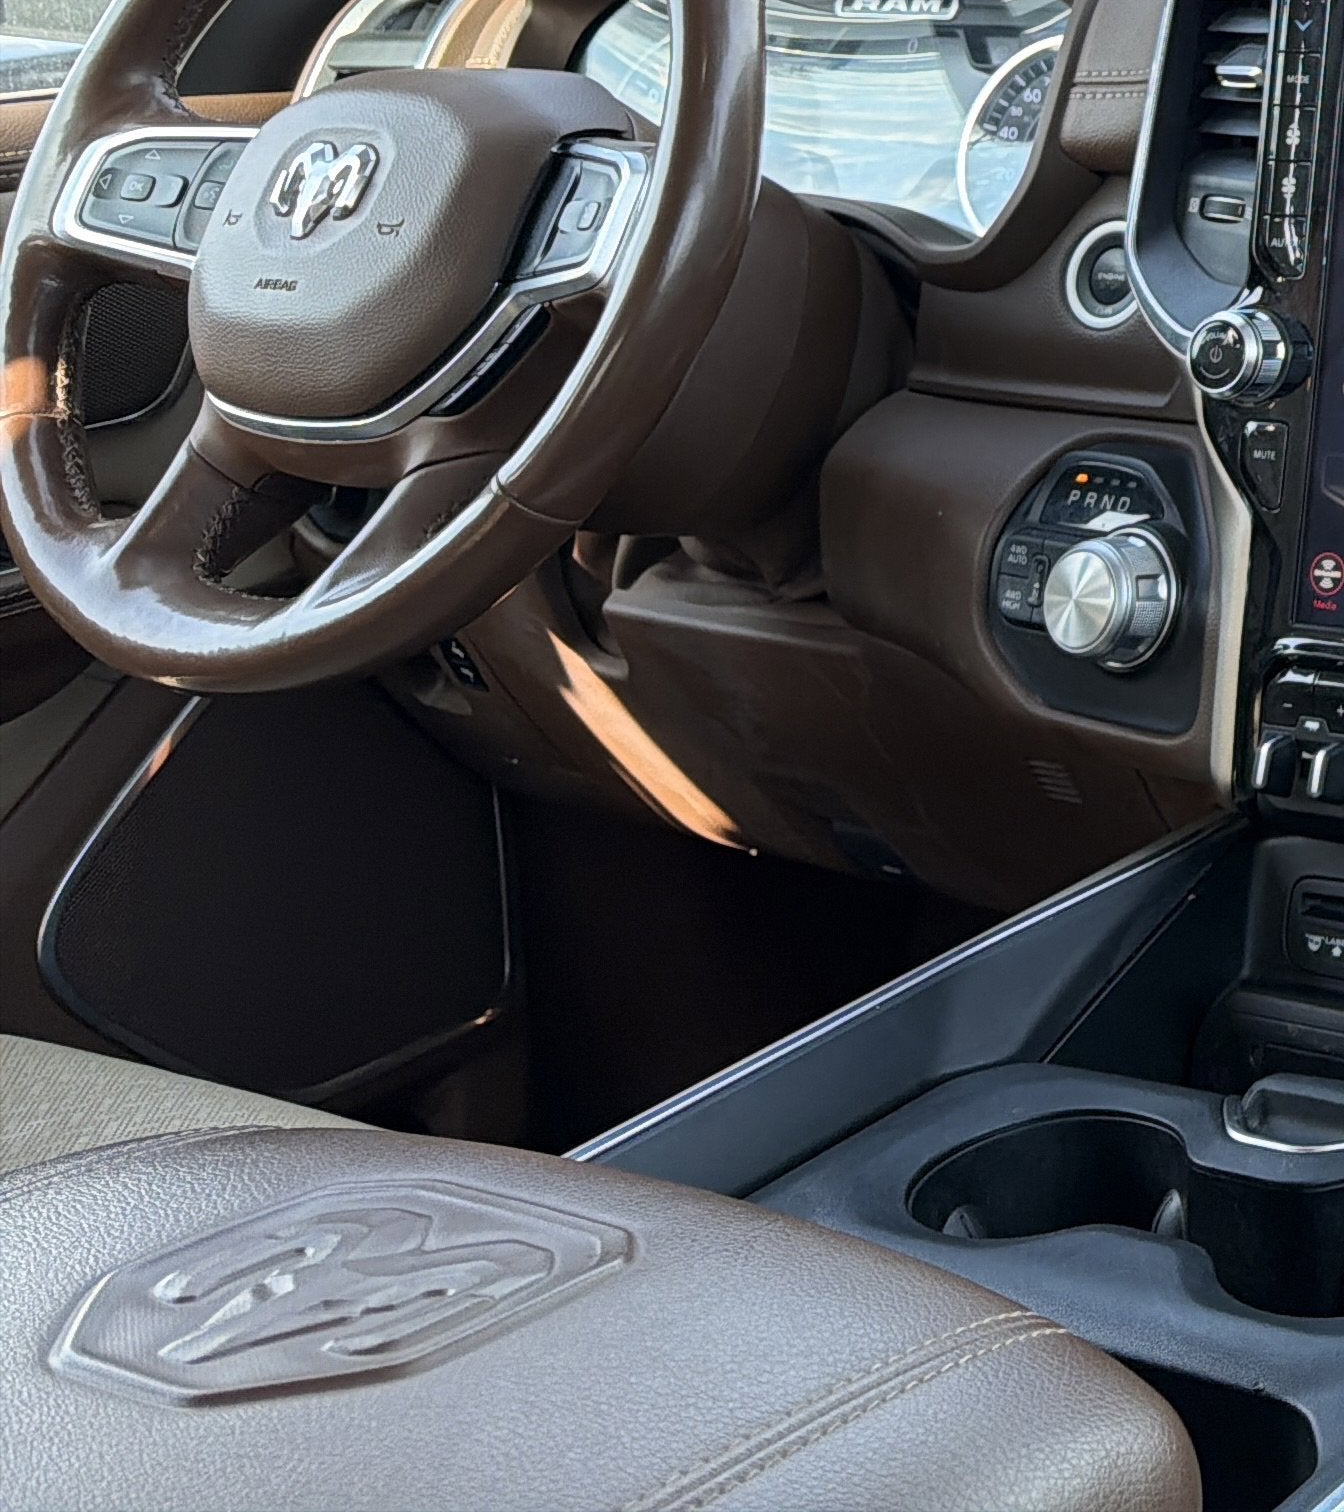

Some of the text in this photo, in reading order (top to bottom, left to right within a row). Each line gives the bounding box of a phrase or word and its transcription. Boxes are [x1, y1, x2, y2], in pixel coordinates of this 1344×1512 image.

[1023, 88, 1042, 103] 60
[1000, 125, 1019, 140] 40
[253, 277, 298, 292] AIRBAG
[1253, 450, 1276, 461] MUTE
[1067, 490, 1131, 512] P R N D
[1010, 543, 1028, 555] 4WD
[1007, 554, 1028, 566] AUTO
[1313, 600, 1337, 611] Media
